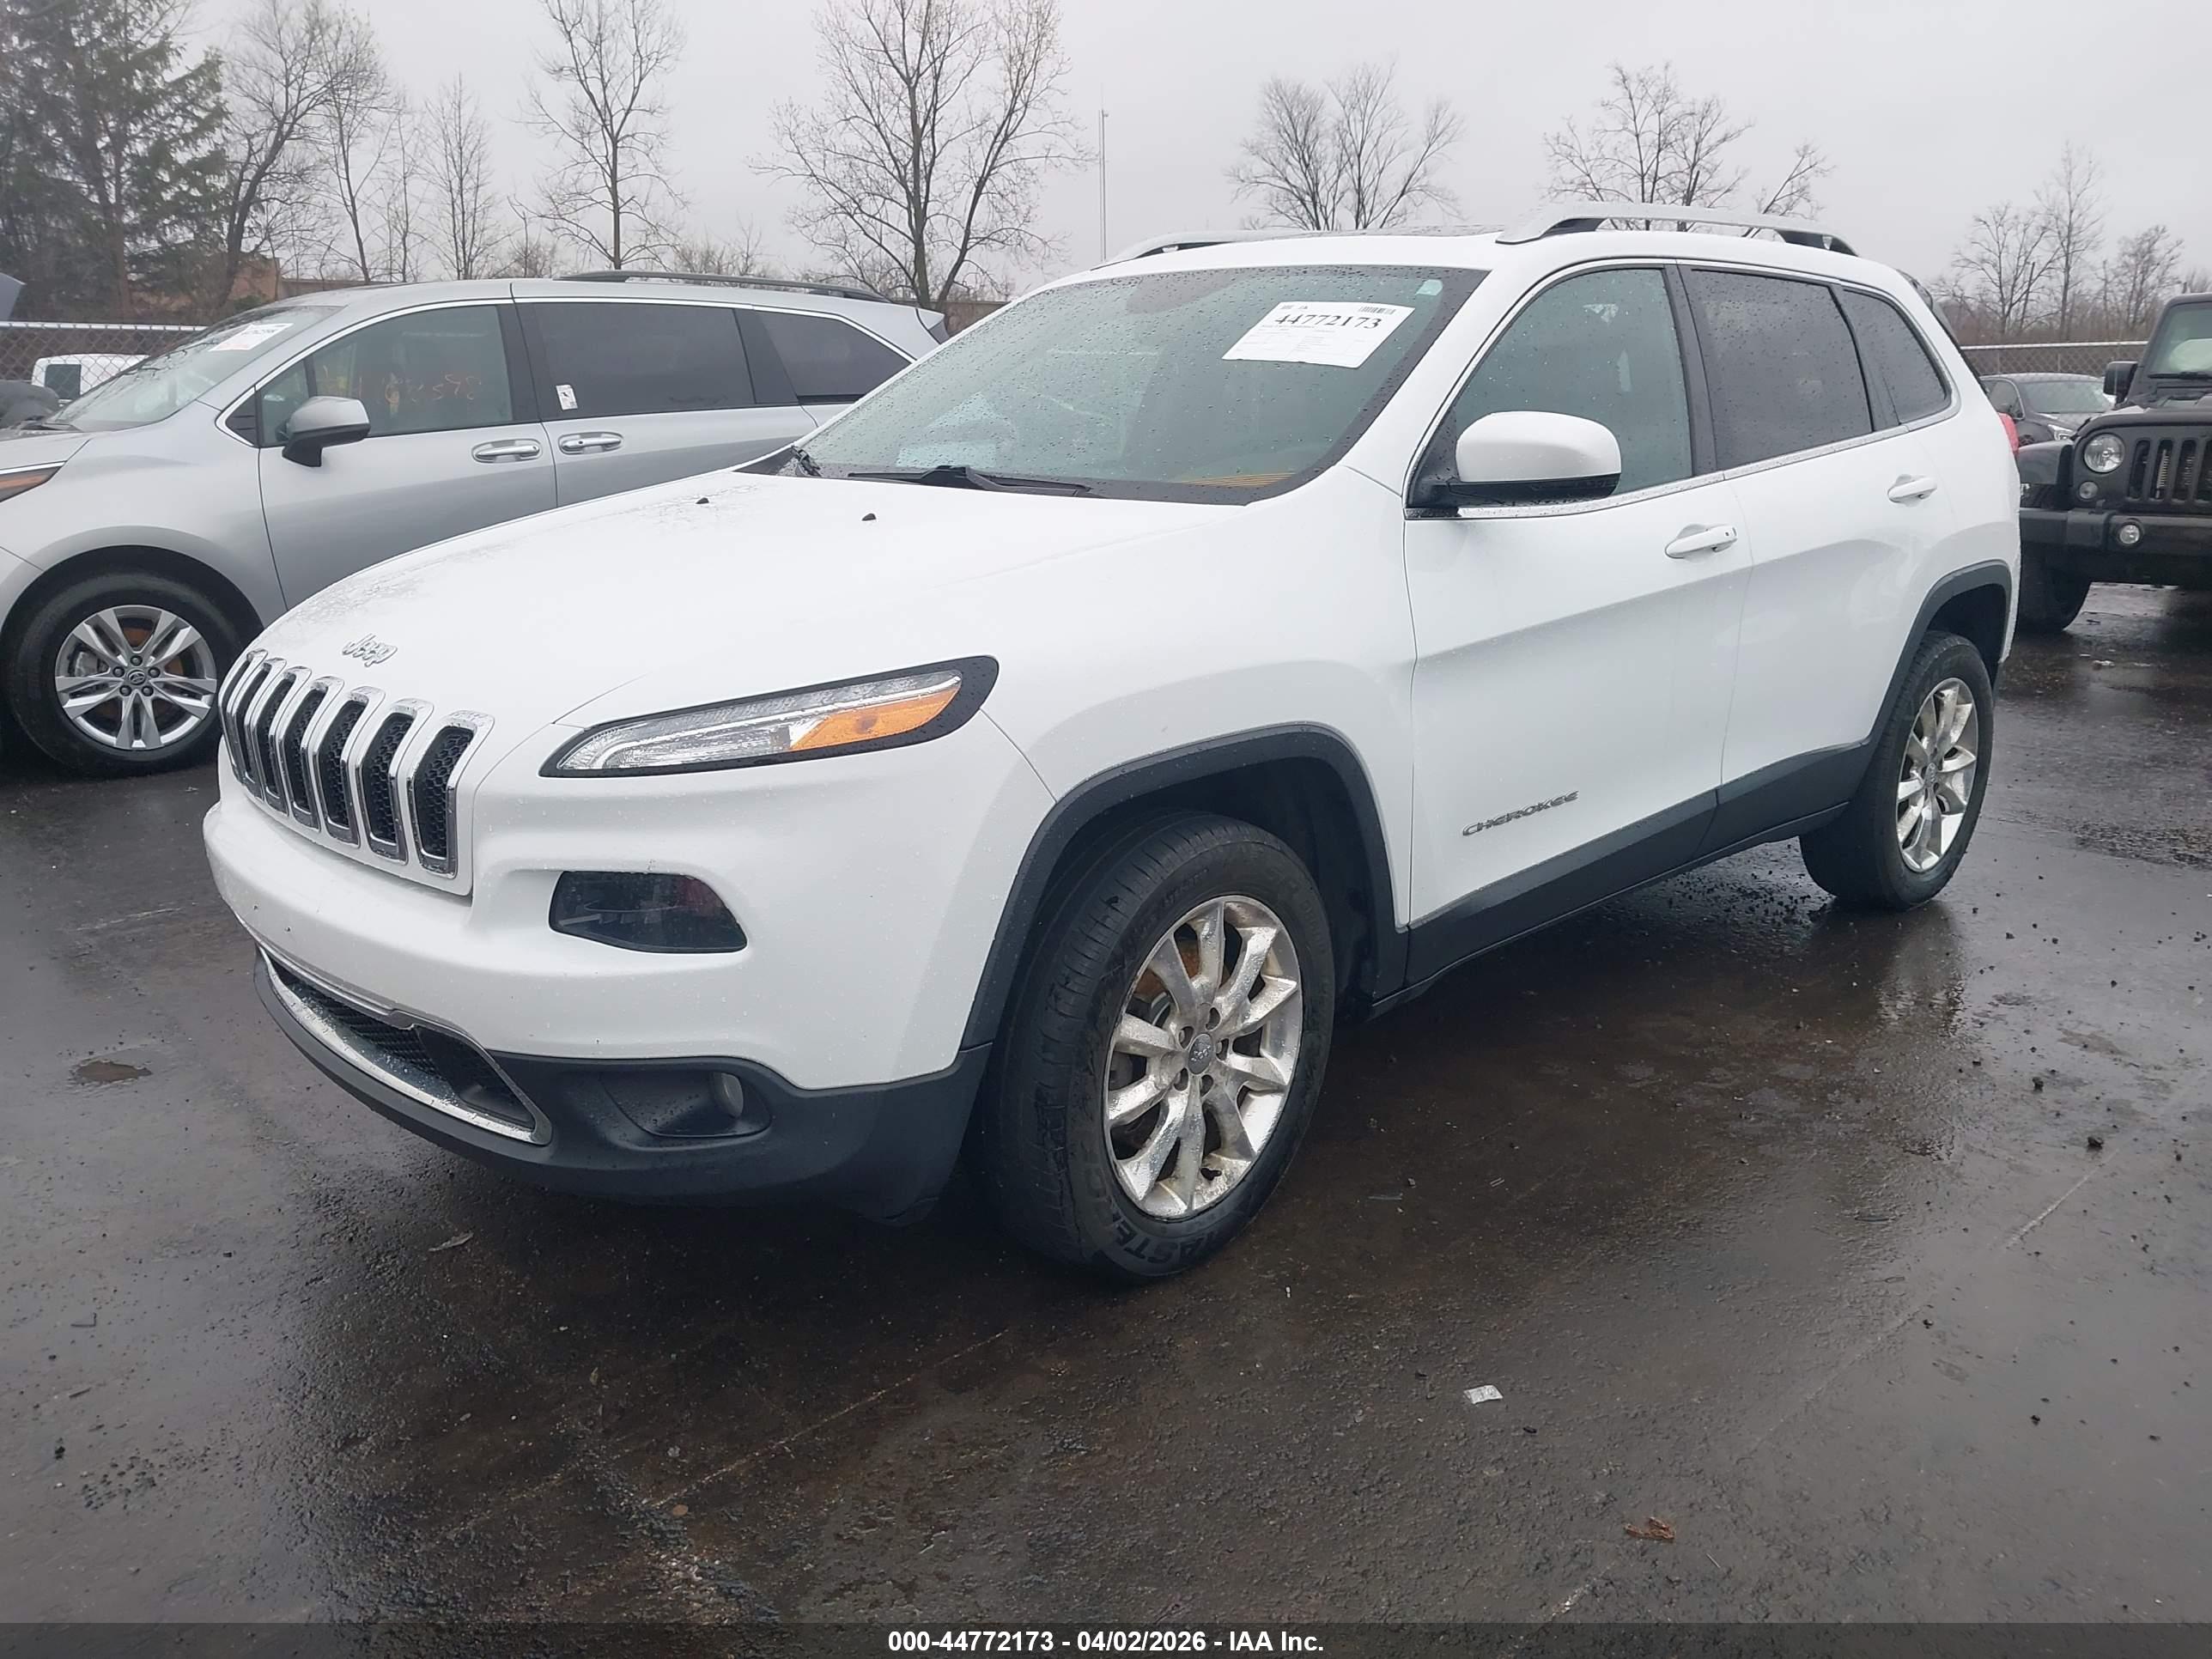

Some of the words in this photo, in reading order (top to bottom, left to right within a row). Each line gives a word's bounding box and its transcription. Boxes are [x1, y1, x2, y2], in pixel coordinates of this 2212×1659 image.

[1274, 313, 1382, 329] 44772173
[342, 632, 398, 667] Jeep
[1462, 790, 1579, 836] CHEROKEE
